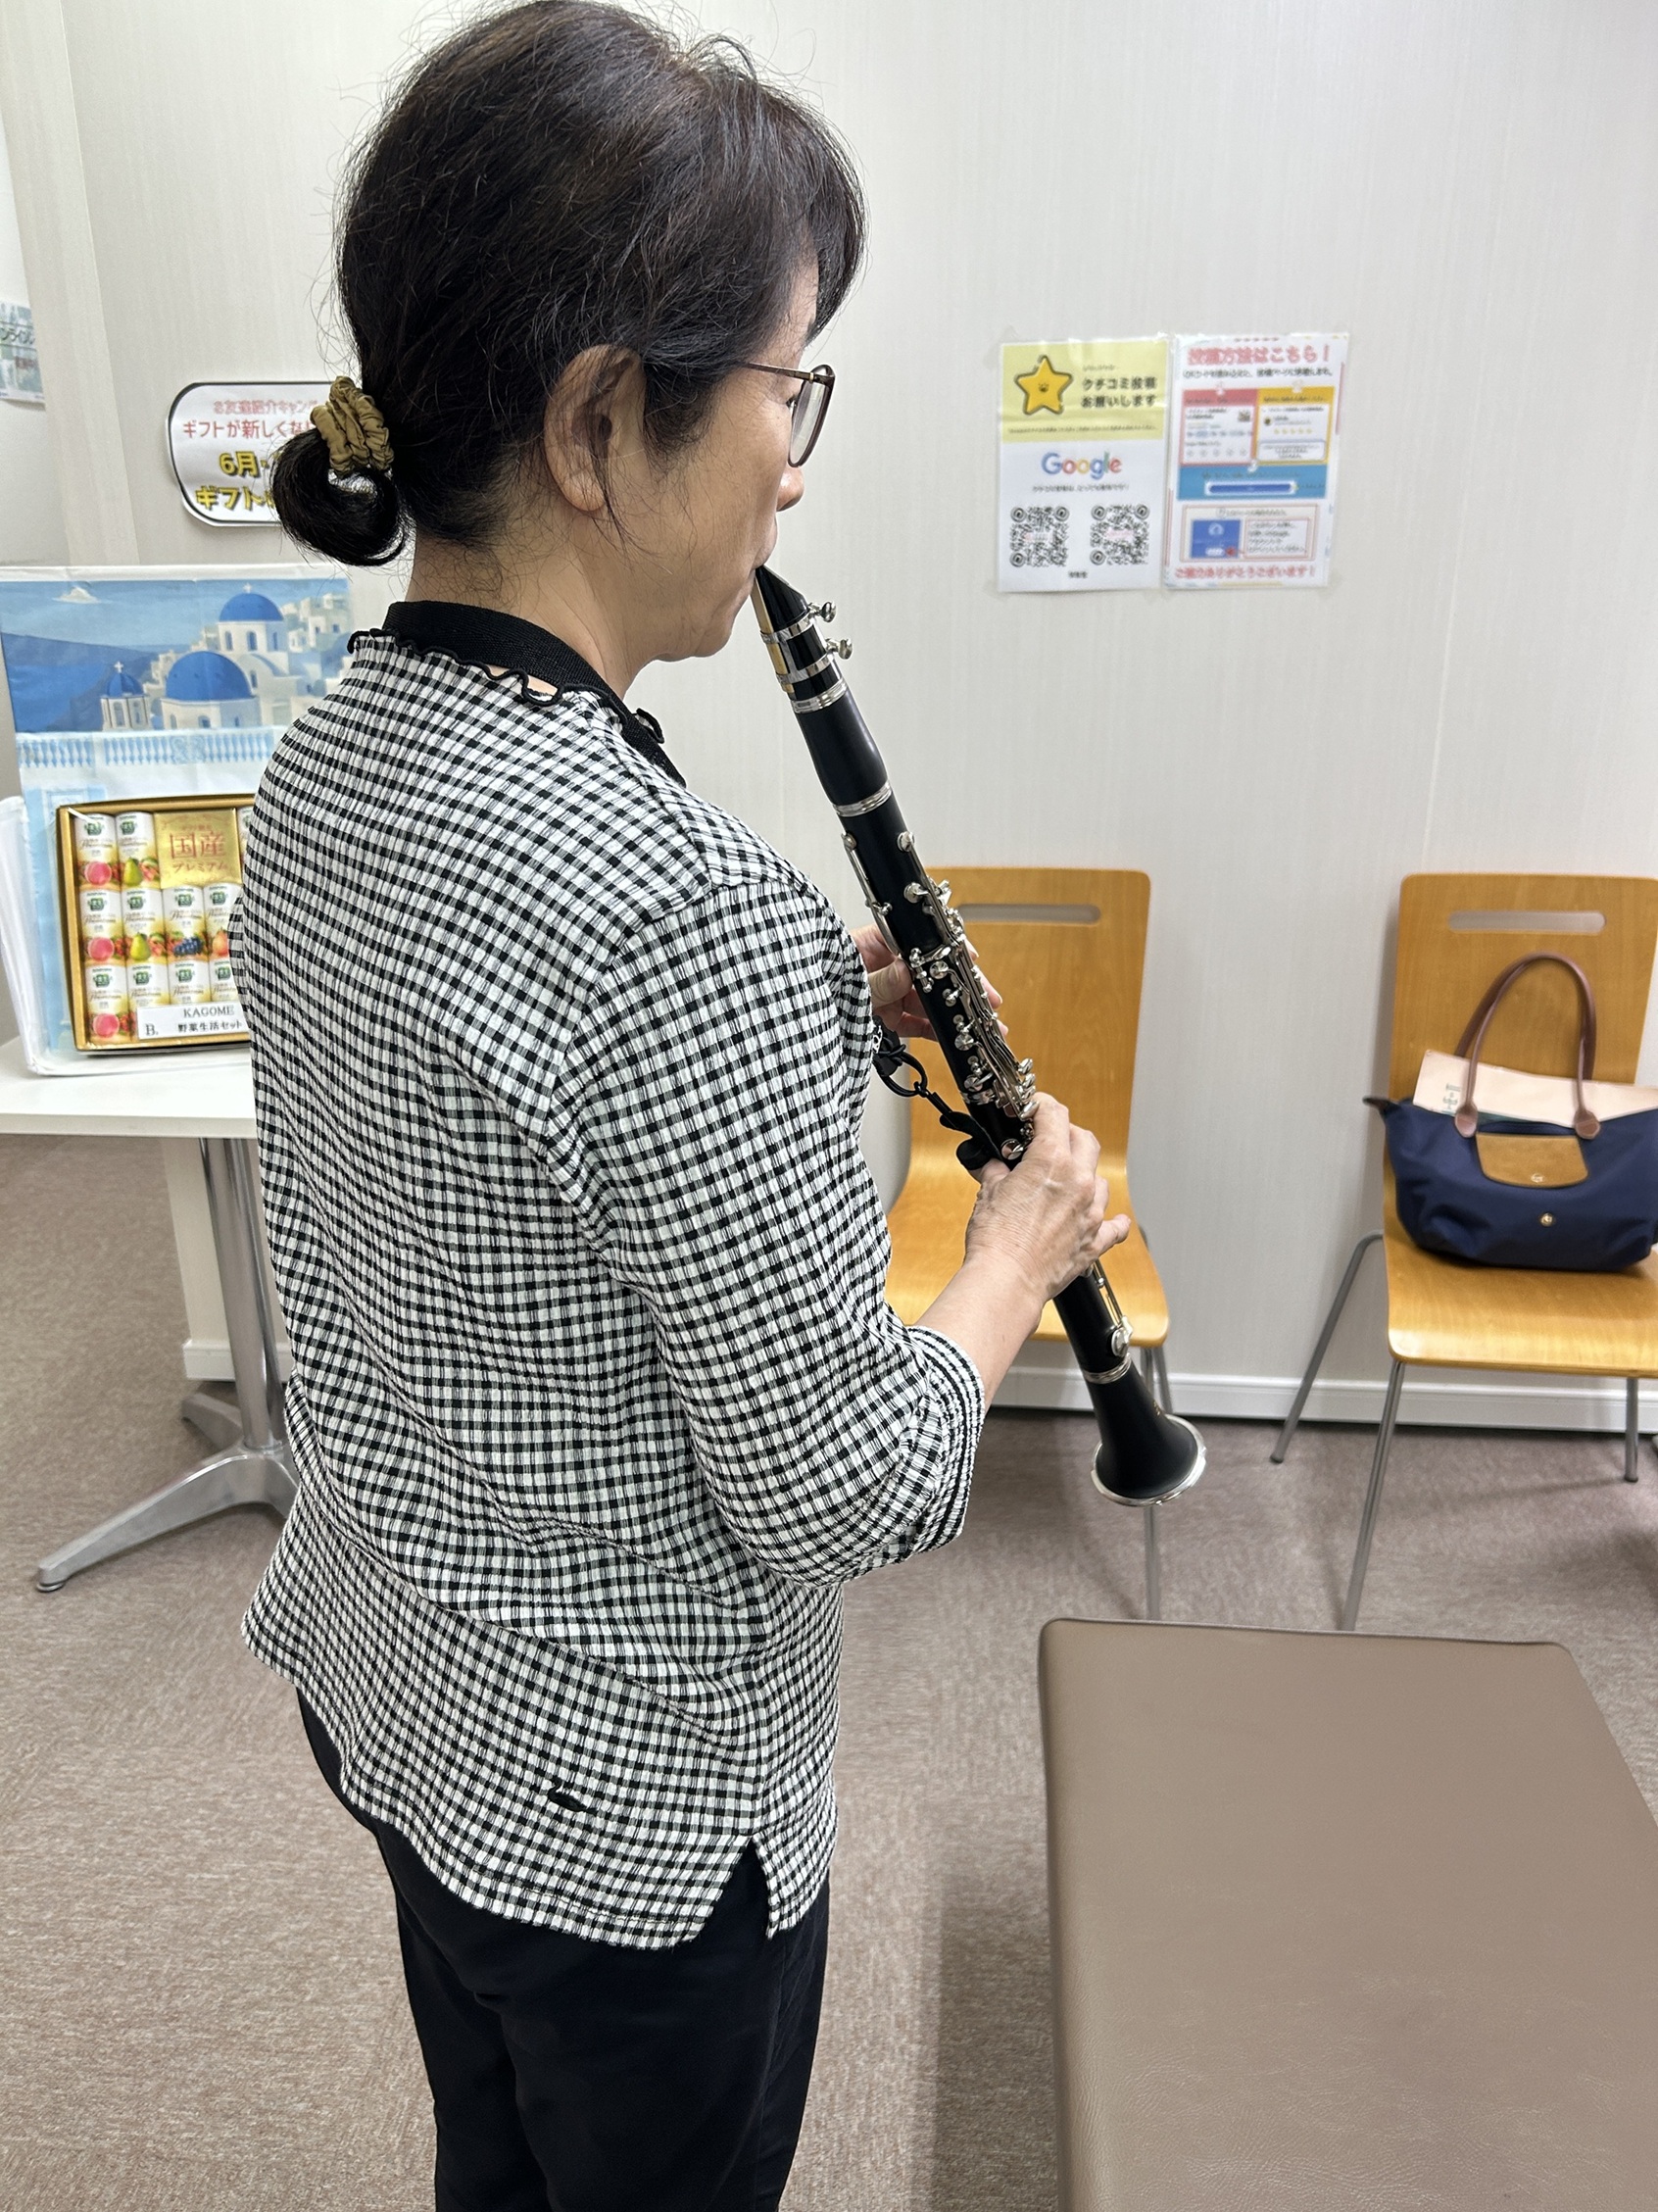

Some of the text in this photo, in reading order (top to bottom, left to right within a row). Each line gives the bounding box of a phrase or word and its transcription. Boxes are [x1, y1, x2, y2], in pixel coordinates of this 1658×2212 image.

[1041, 451, 1123, 480] Google
[170, 830, 226, 860] 国産
[172, 860, 228, 873] プレミアム
[183, 1005, 235, 1018] KAGOME
[145, 1019, 243, 1037] B. 野菜生活セット
